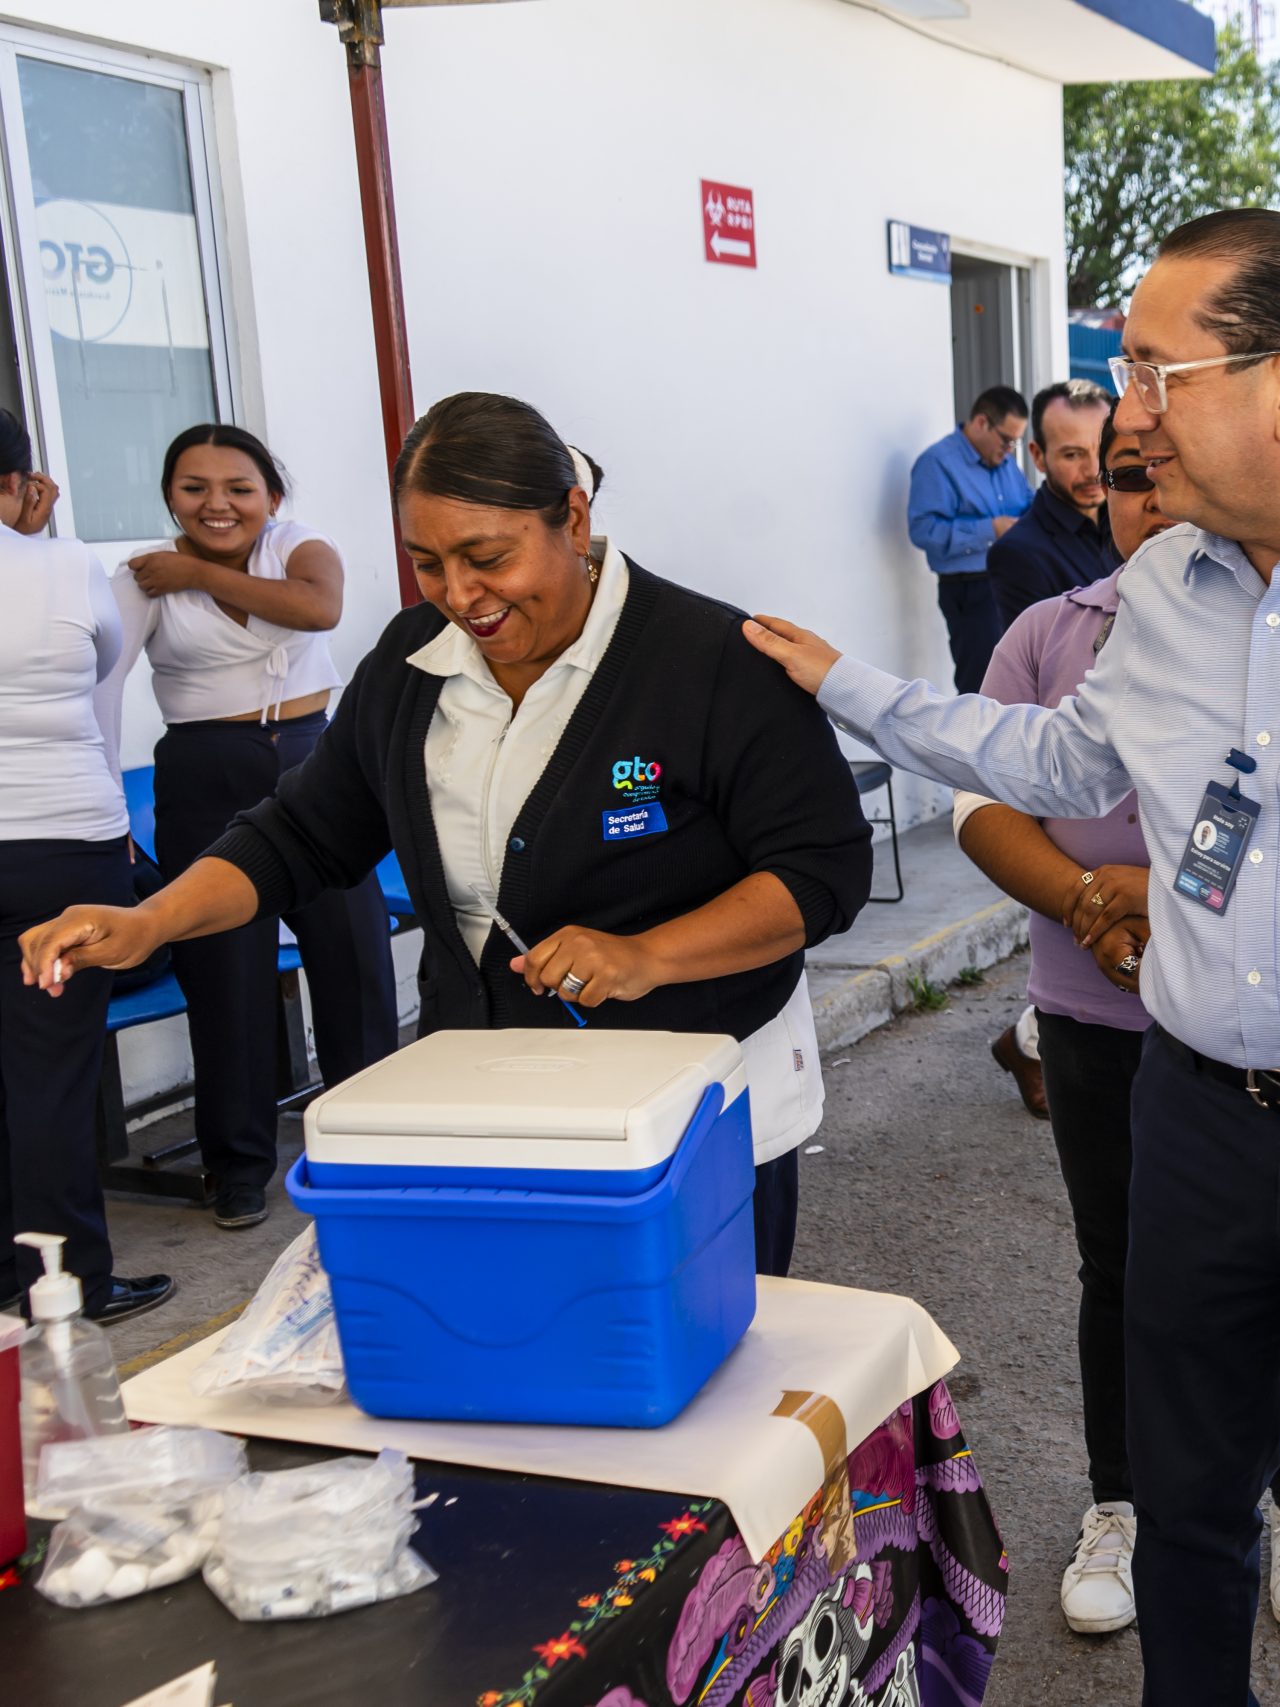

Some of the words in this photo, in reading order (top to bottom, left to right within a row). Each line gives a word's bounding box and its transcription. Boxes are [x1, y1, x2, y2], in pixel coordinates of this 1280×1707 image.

[726, 195, 752, 213] RUTA
[612, 756, 662, 790] gto
[608, 809, 649, 825] Secretaría
[608, 825, 620, 835] de
[623, 821, 645, 833] Salud
